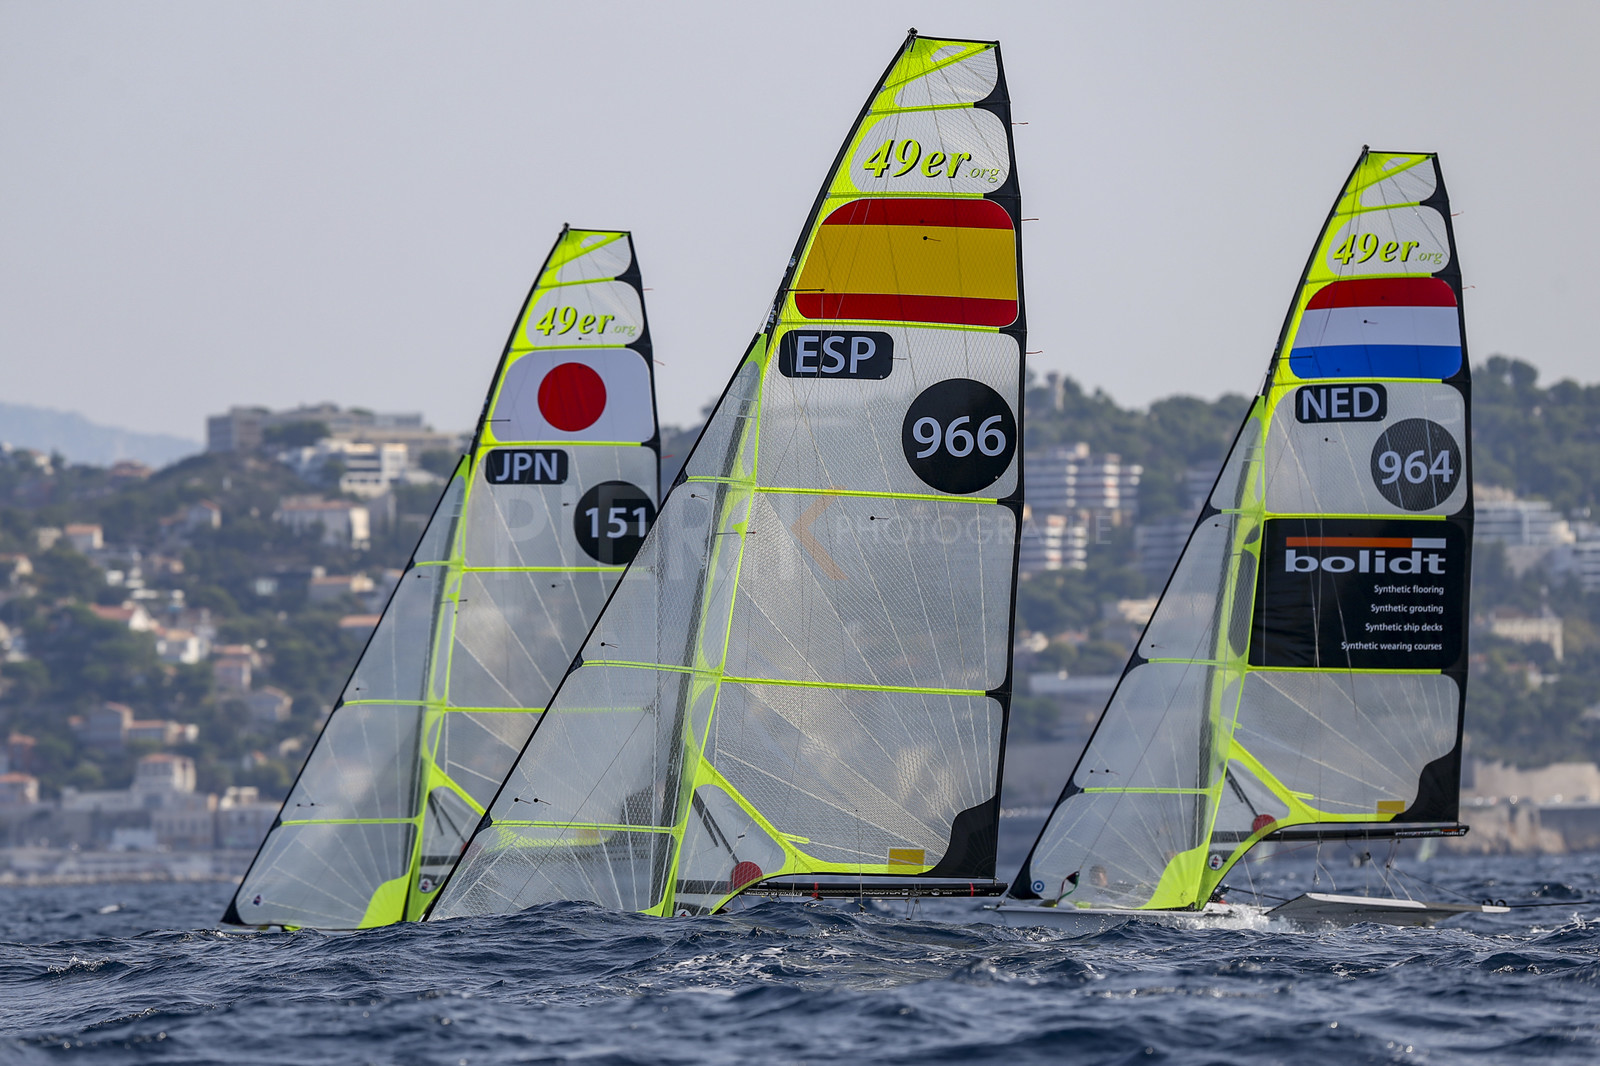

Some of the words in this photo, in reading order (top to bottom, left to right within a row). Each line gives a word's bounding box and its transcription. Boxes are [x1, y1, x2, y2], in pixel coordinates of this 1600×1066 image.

[795, 335, 876, 374] ESP
[1302, 386, 1380, 420] NED
[912, 414, 1007, 459] 966
[495, 452, 558, 482] JPN
[1378, 449, 1454, 485] 964
[585, 507, 647, 539] 151
[1285, 549, 1447, 575] bolidt
[1374, 584, 1411, 595] Synthetic
[1412, 585, 1444, 596] flooring
[1370, 603, 1408, 614] Synthetic
[1409, 604, 1444, 615] grouting
[1365, 622, 1402, 633] Synthetic
[1403, 623, 1420, 633] ship
[1421, 623, 1443, 632] decks
[1341, 641, 1378, 652] Synthetic
[1379, 641, 1413, 653] wearing
[1413, 642, 1443, 651] courses
